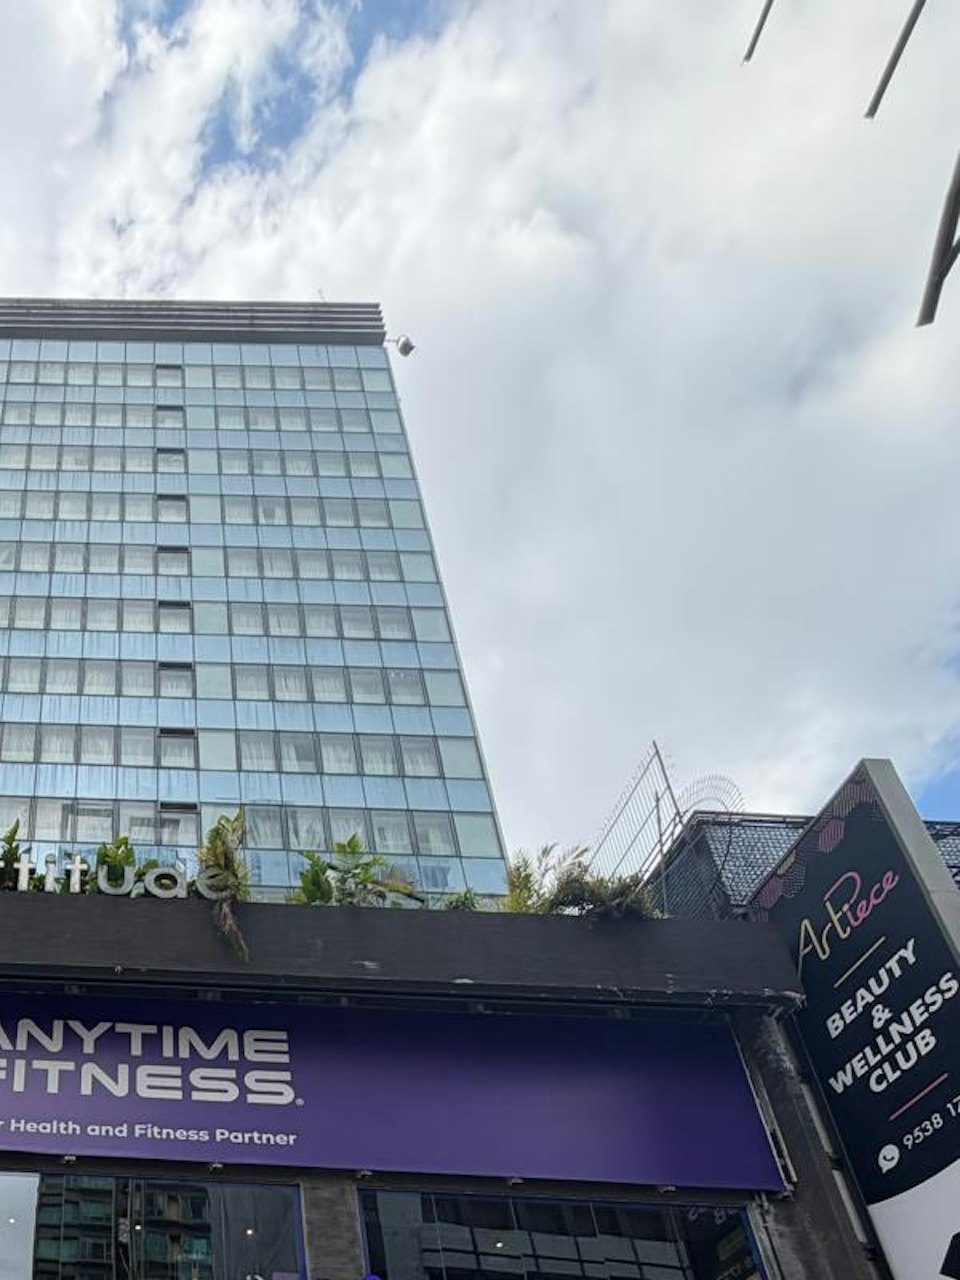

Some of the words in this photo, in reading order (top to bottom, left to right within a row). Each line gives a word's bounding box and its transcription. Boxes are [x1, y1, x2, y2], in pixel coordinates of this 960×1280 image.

[826, 938, 917, 1039] BEAUTY
[829, 972, 959, 1094] WELLNESS
[871, 1003, 892, 1029] &
[869, 1028, 936, 1093] CLUB
[10, 1118, 82, 1136] Health
[87, 1123, 128, 1138] and
[134, 1123, 210, 1142] Fitness
[215, 1128, 297, 1146] Partner
[902, 1112, 944, 1149] 9538
